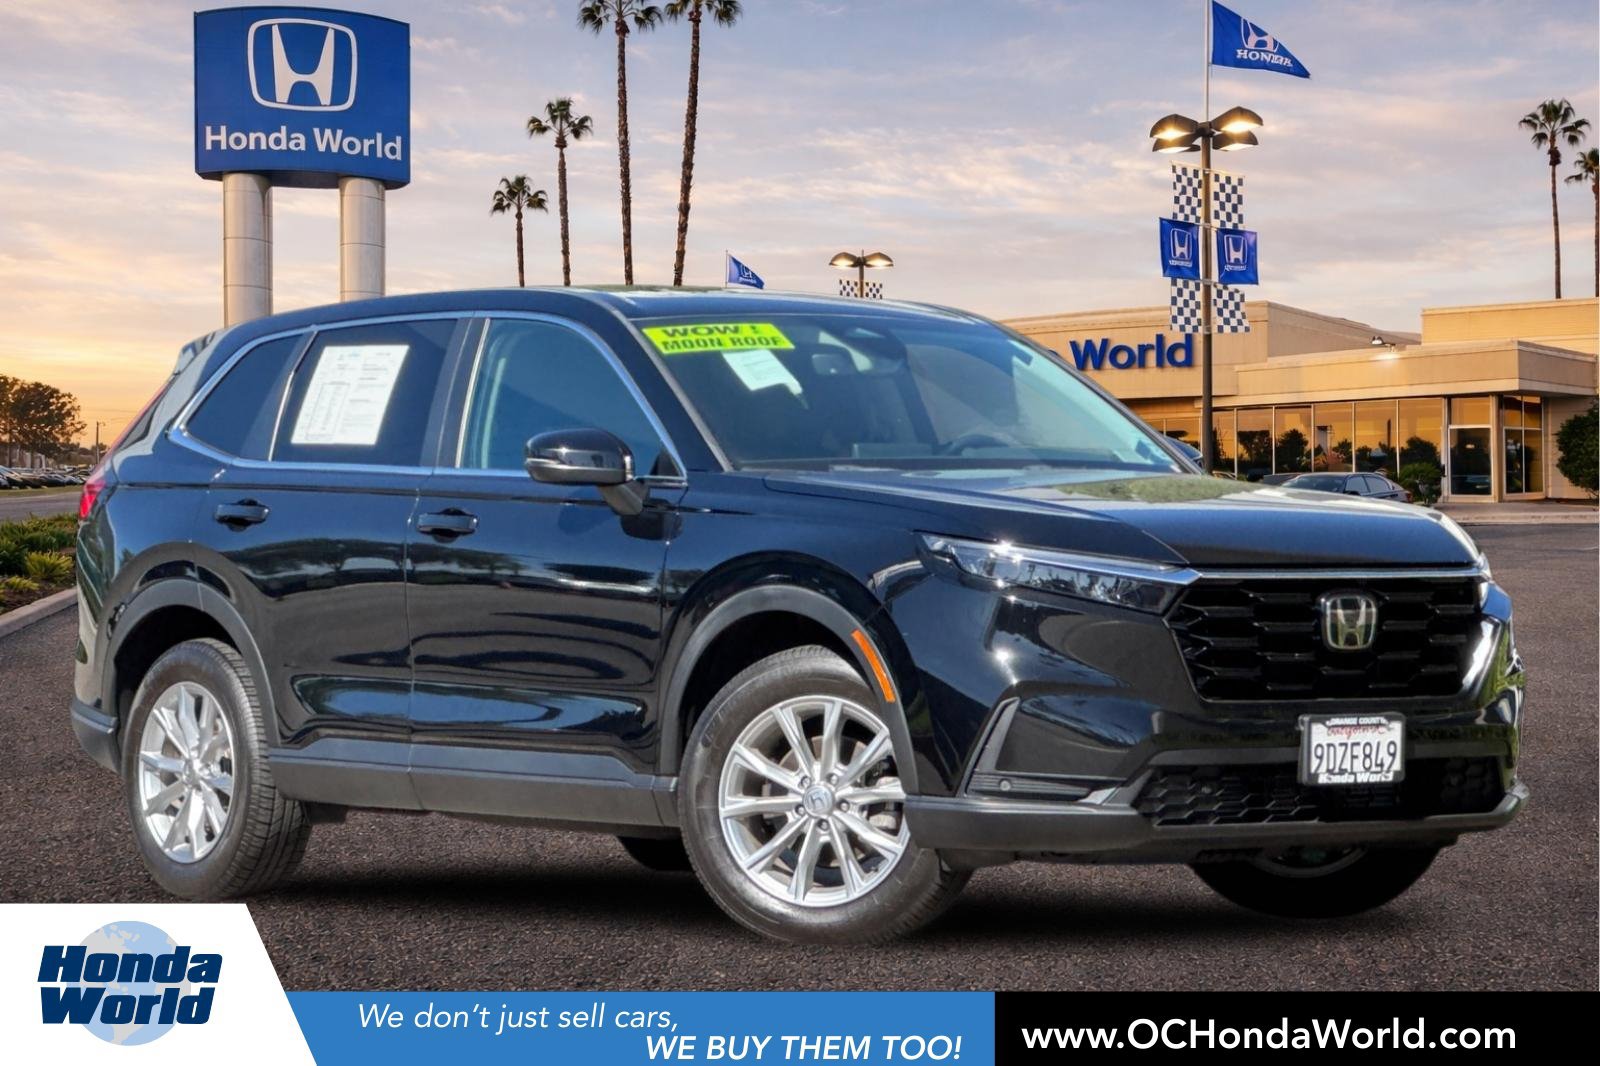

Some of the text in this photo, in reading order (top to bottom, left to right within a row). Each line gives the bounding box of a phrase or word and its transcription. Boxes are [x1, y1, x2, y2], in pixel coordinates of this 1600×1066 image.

[205, 125, 402, 161] Honda World
[661, 336, 781, 351] MOON ROOF
[662, 325, 739, 338] WOW
[1069, 333, 1195, 371] World
[1313, 740, 1398, 774] 9DZF849
